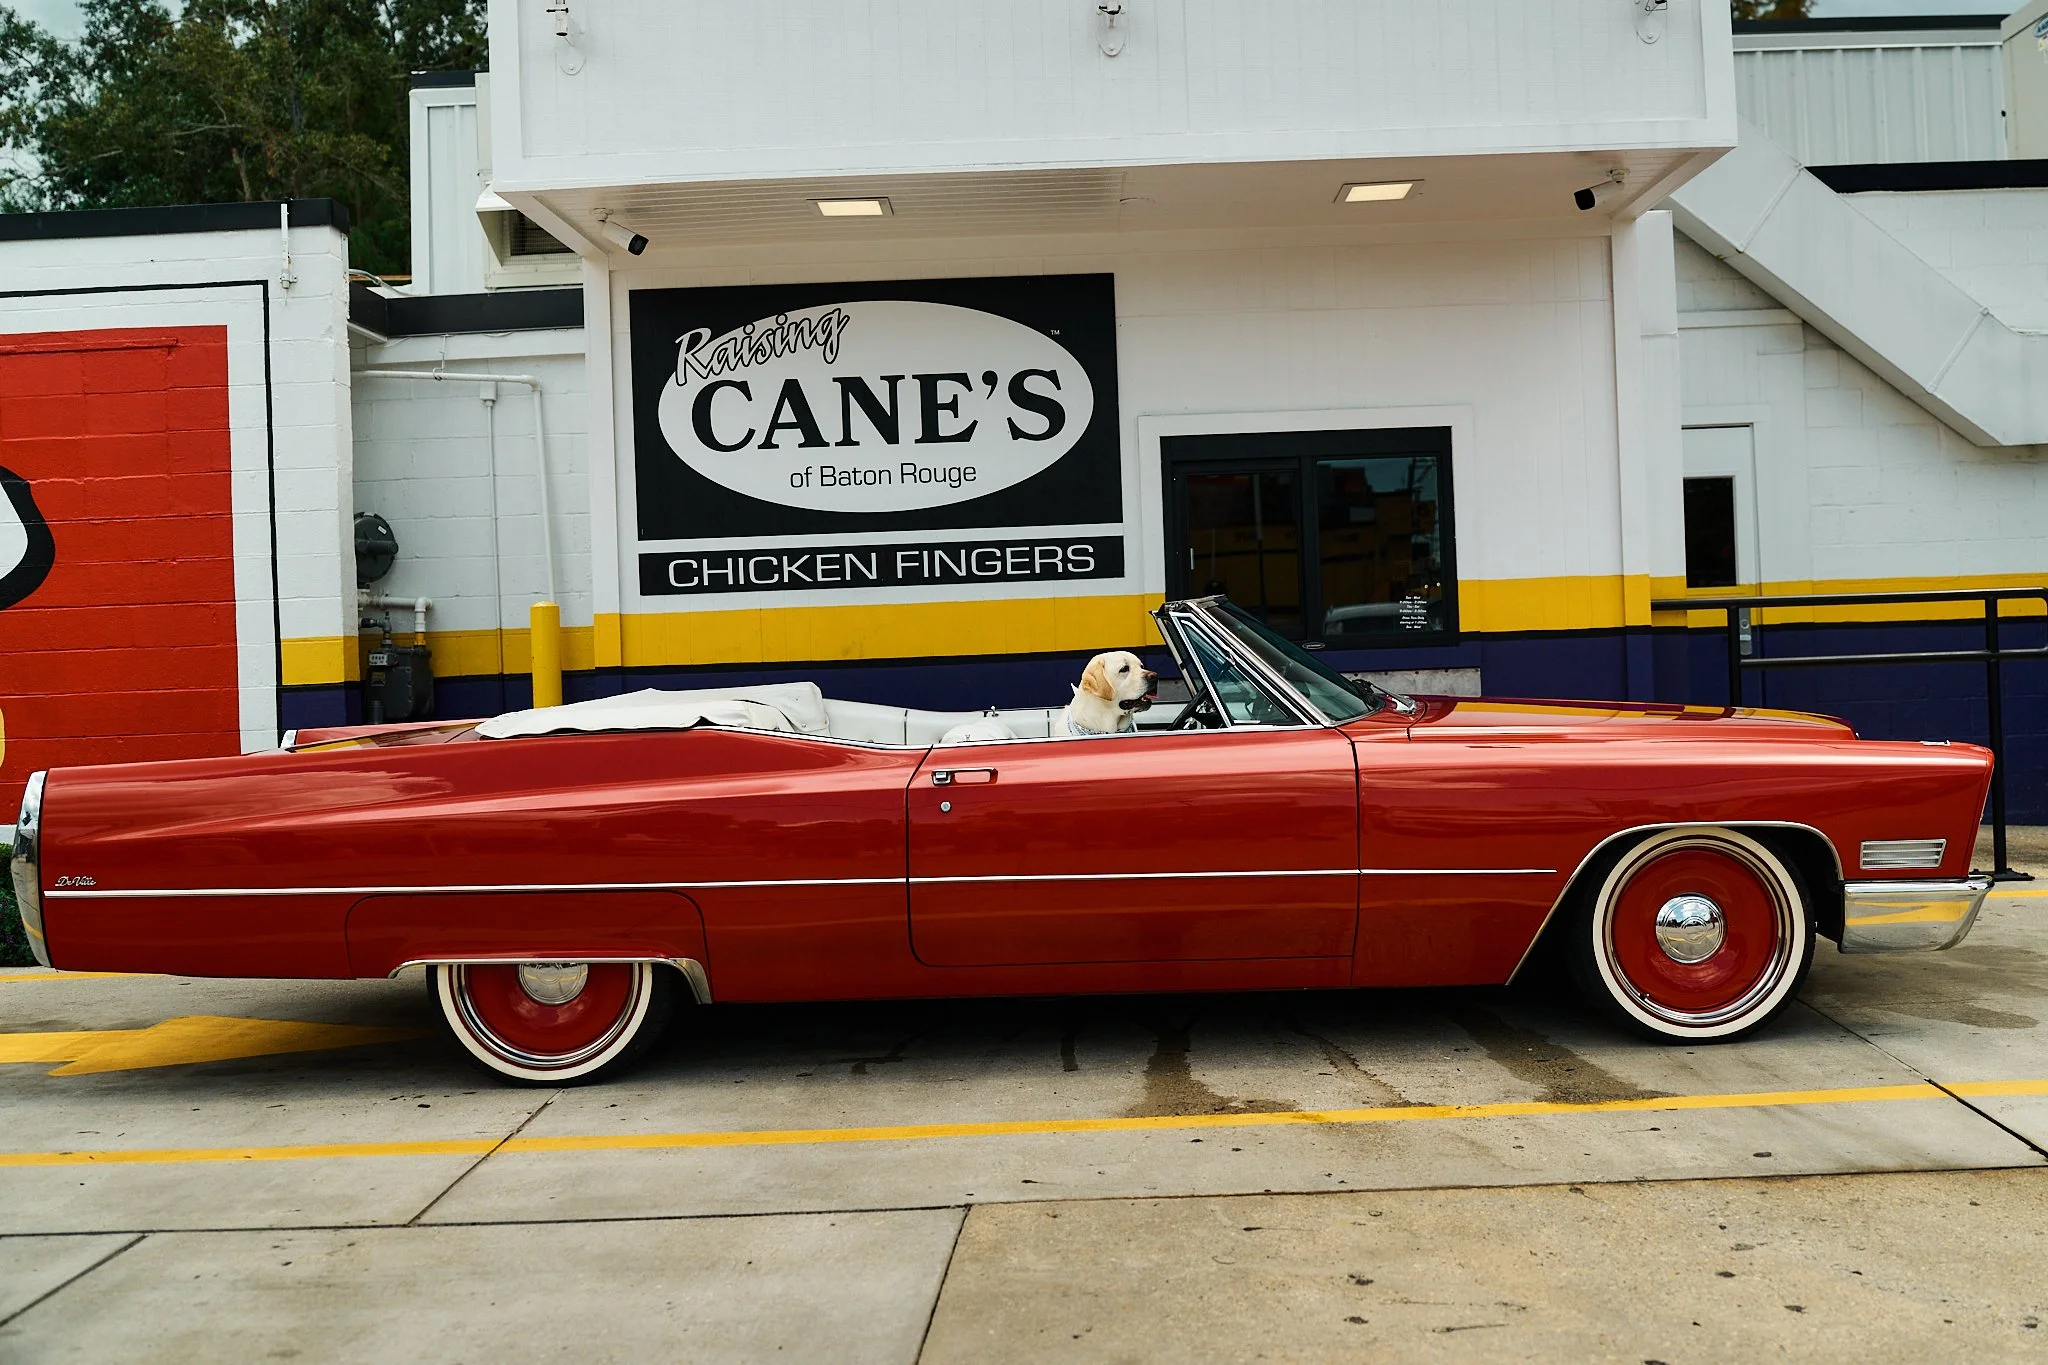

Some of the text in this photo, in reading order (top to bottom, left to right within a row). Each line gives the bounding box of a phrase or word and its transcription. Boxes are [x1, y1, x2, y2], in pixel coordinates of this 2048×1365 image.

[675, 308, 851, 387] Raising
[691, 368, 1067, 453] CANE'S
[790, 462, 977, 489] of Baton Rouge
[668, 544, 1095, 588] CHICKEN FINGERS
